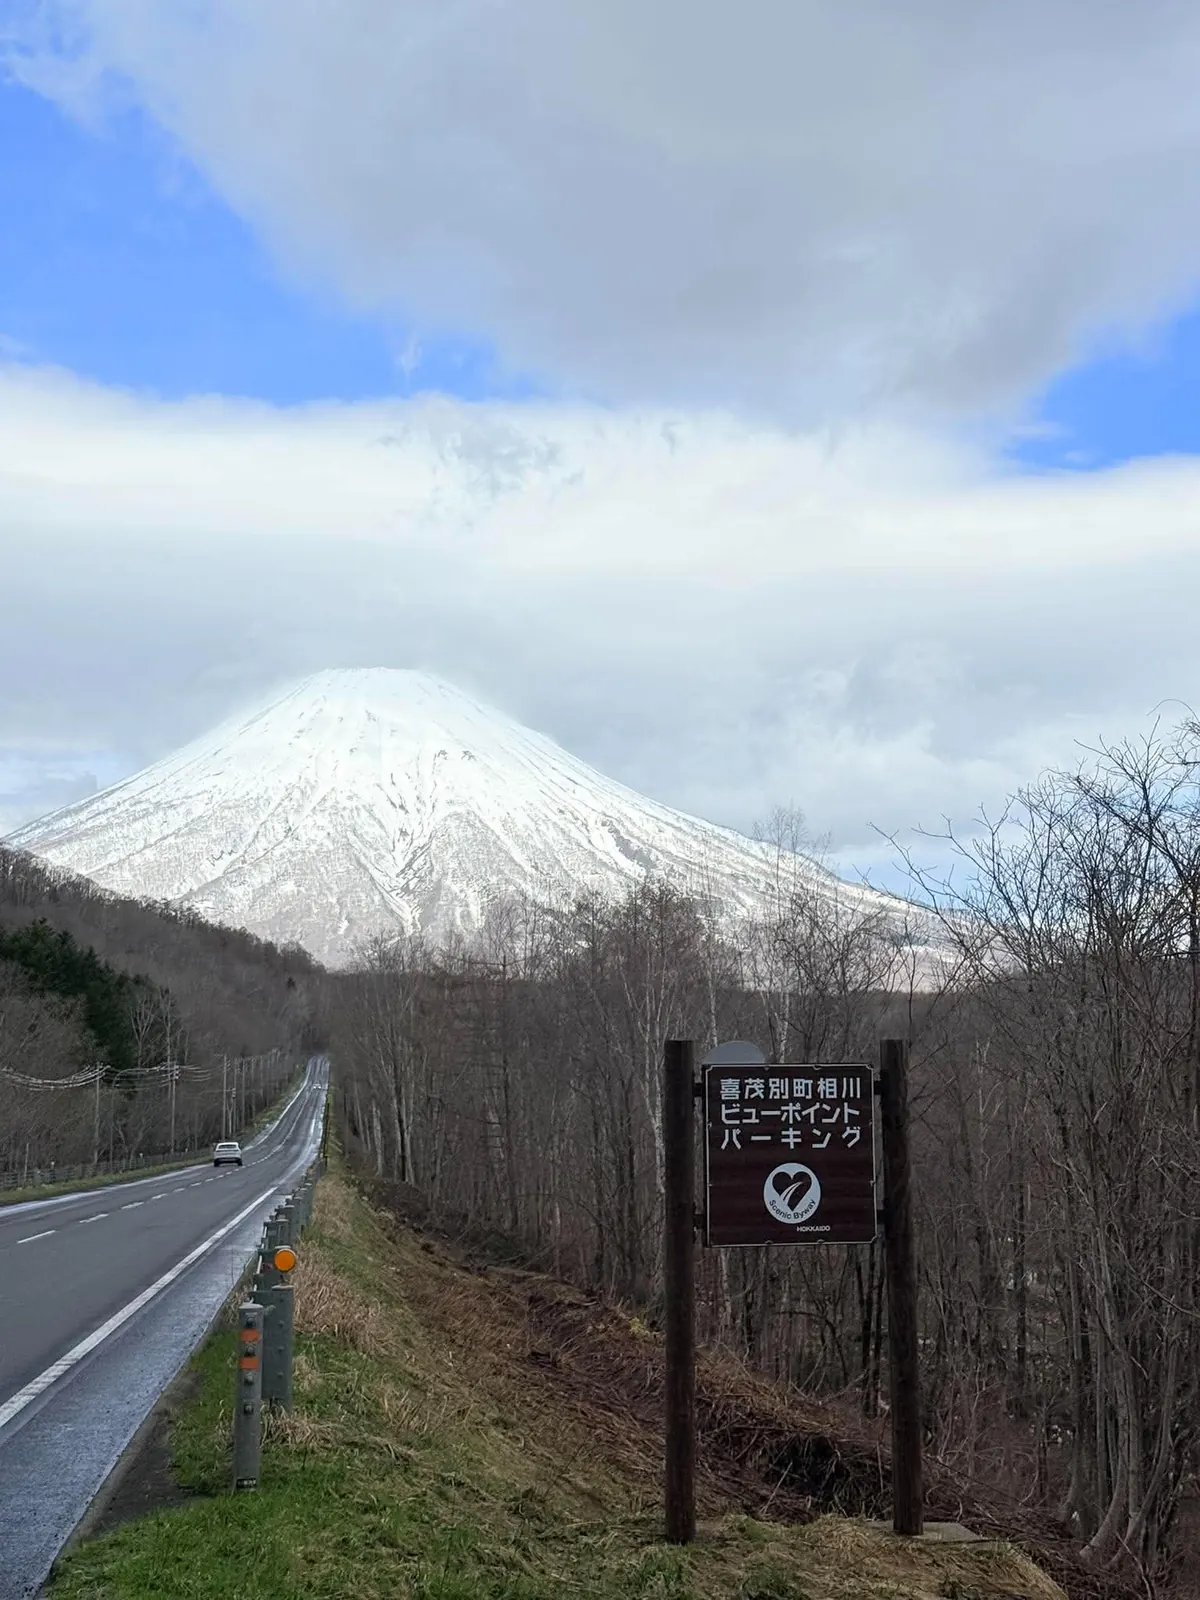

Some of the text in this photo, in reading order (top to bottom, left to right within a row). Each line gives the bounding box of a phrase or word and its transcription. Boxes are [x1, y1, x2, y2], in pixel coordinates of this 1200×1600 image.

[720, 1078, 861, 1100] 喜茂別町相川
[721, 1102, 860, 1124] ビューポイント
[720, 1126, 861, 1150] パーキング
[769, 1198, 816, 1219] Scenic Byway
